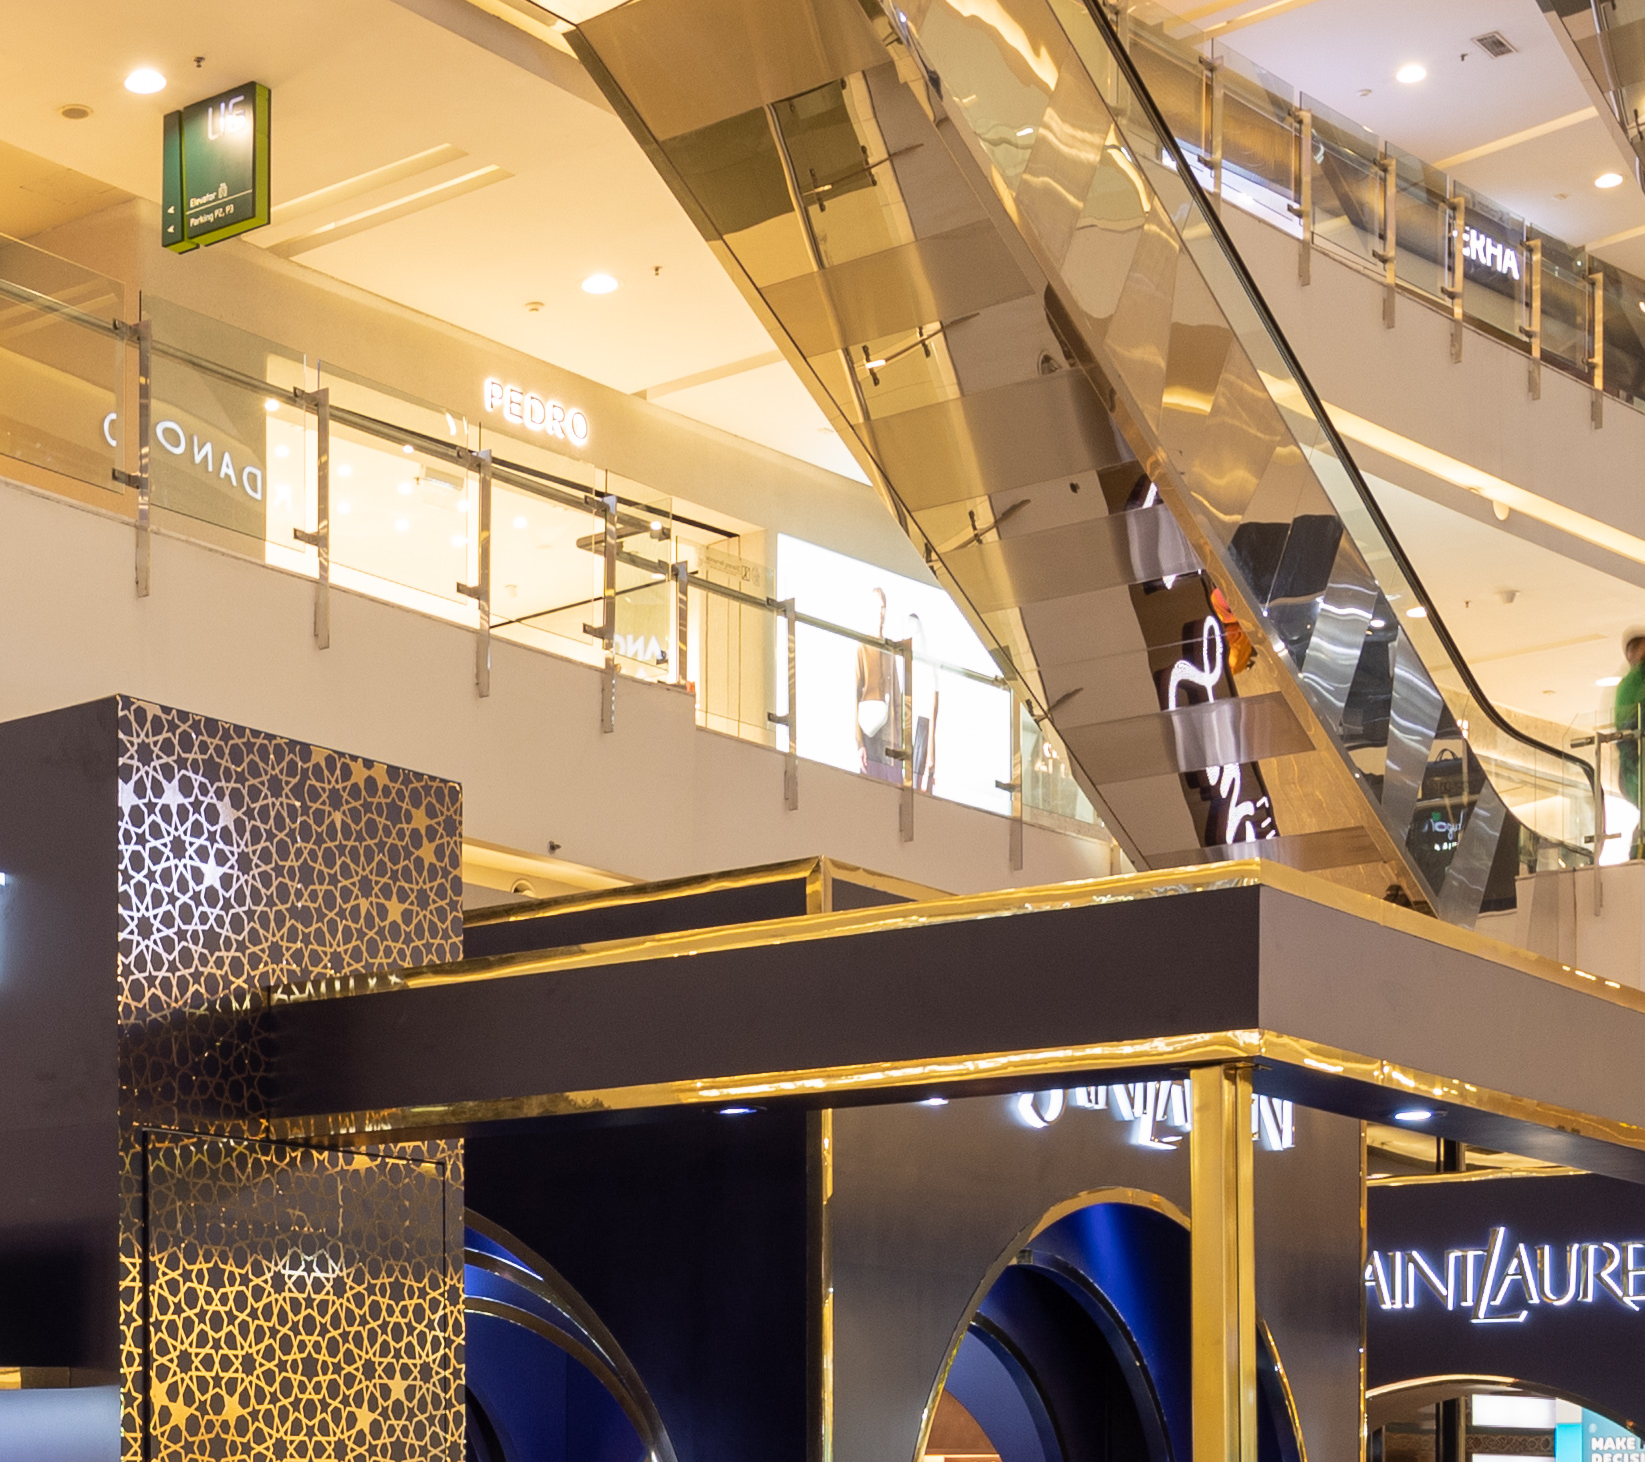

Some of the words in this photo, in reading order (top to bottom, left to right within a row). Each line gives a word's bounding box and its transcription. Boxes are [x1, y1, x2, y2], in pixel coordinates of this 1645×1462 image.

[190, 190, 217, 208] Elevator
[190, 211, 214, 227] Parking
[484, 377, 589, 446] PEDRO
[1591, 1436, 1636, 1451] MAKE
